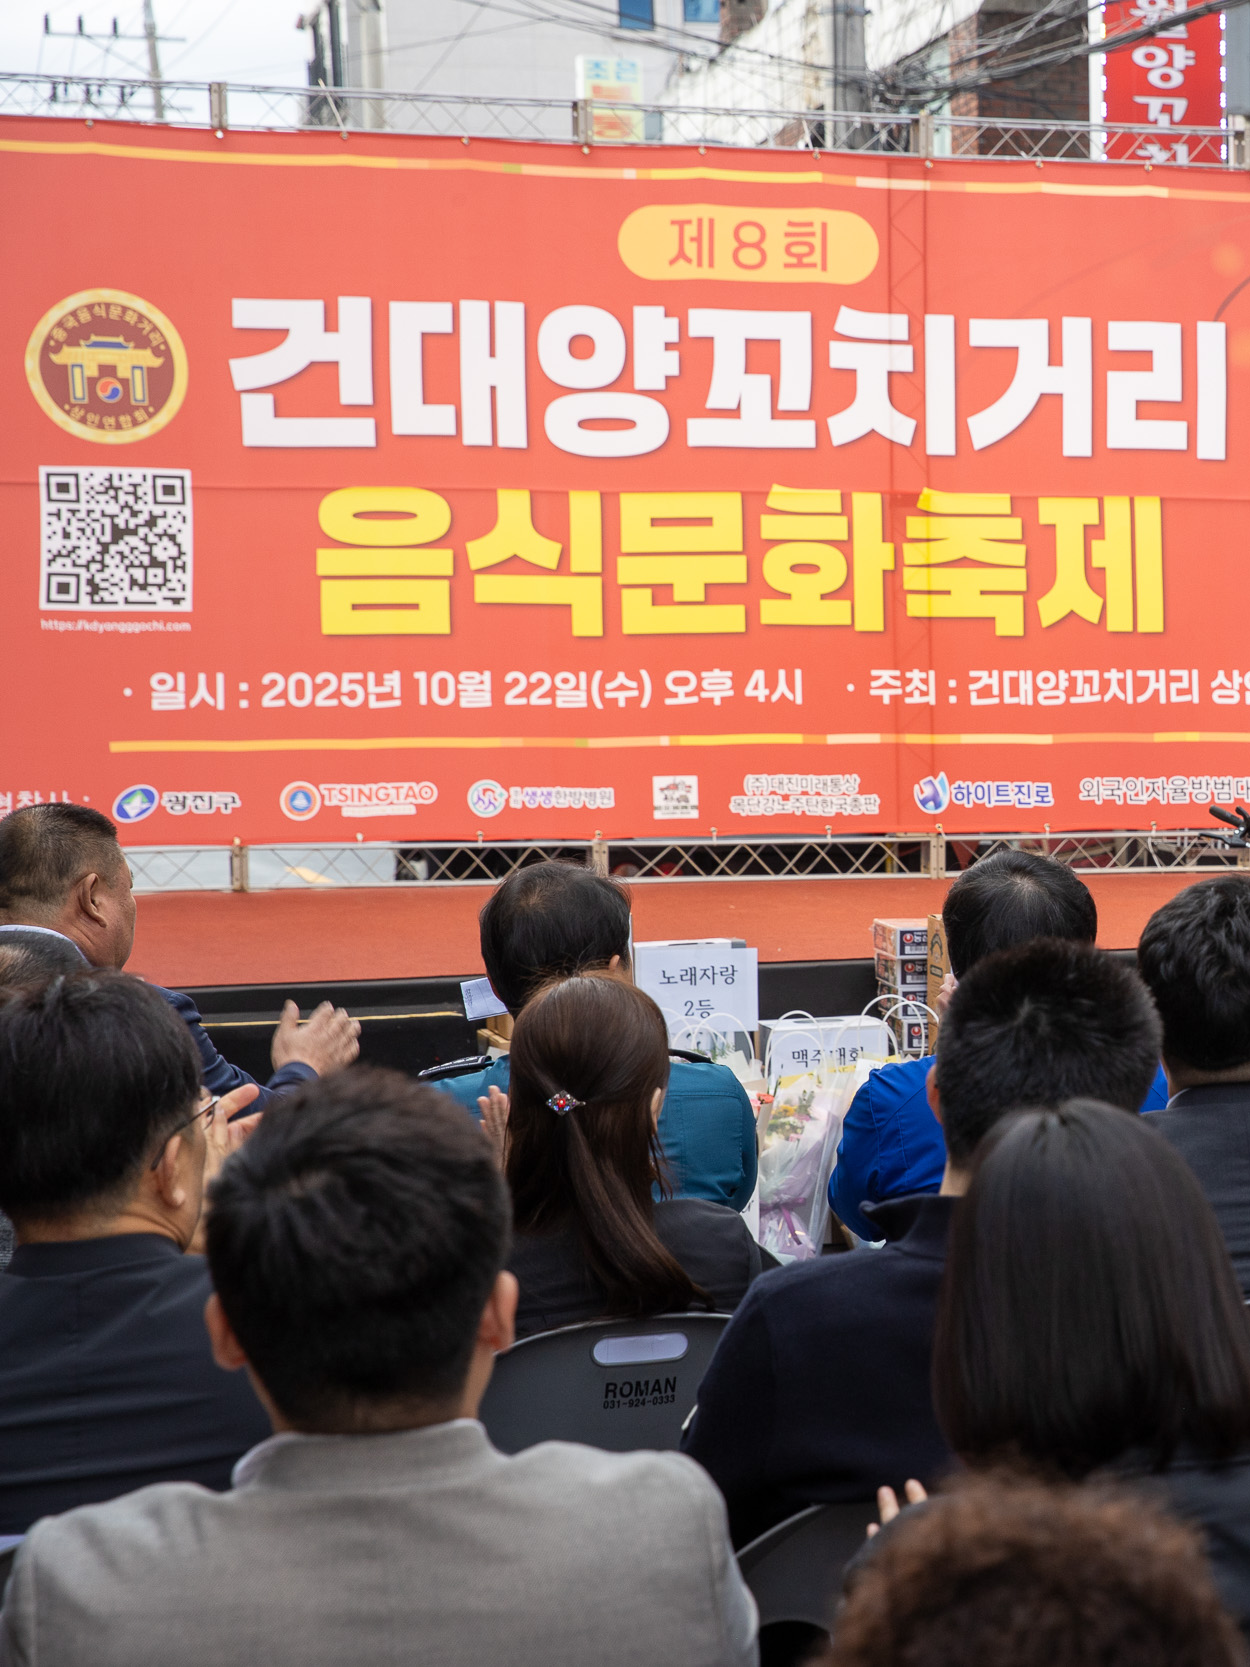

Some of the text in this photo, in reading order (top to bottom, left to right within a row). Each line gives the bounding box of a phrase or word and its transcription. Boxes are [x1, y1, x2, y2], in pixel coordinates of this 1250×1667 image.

[229, 296, 1227, 461] 건대양꼬치거리
[316, 484, 1165, 638] 음식문화축제
[150, 671, 226, 711] 일시
[261, 669, 402, 709] 2025년
[413, 669, 493, 708] 10월
[504, 668, 653, 709] 22일(수)
[664, 668, 734, 706] 오후
[744, 668, 803, 706] 4시
[869, 669, 936, 706] 주최
[968, 668, 1200, 706] 건대양꼬치거리
[168, 793, 237, 813] 광진구
[323, 784, 435, 804] TSINGTAO
[953, 783, 1053, 806] 하이트진로
[659, 964, 738, 987] 노래자랑
[684, 999, 715, 1020] 2등
[604, 1376, 677, 1400] ROMAN
[603, 1394, 675, 1410] 031-924-0333
